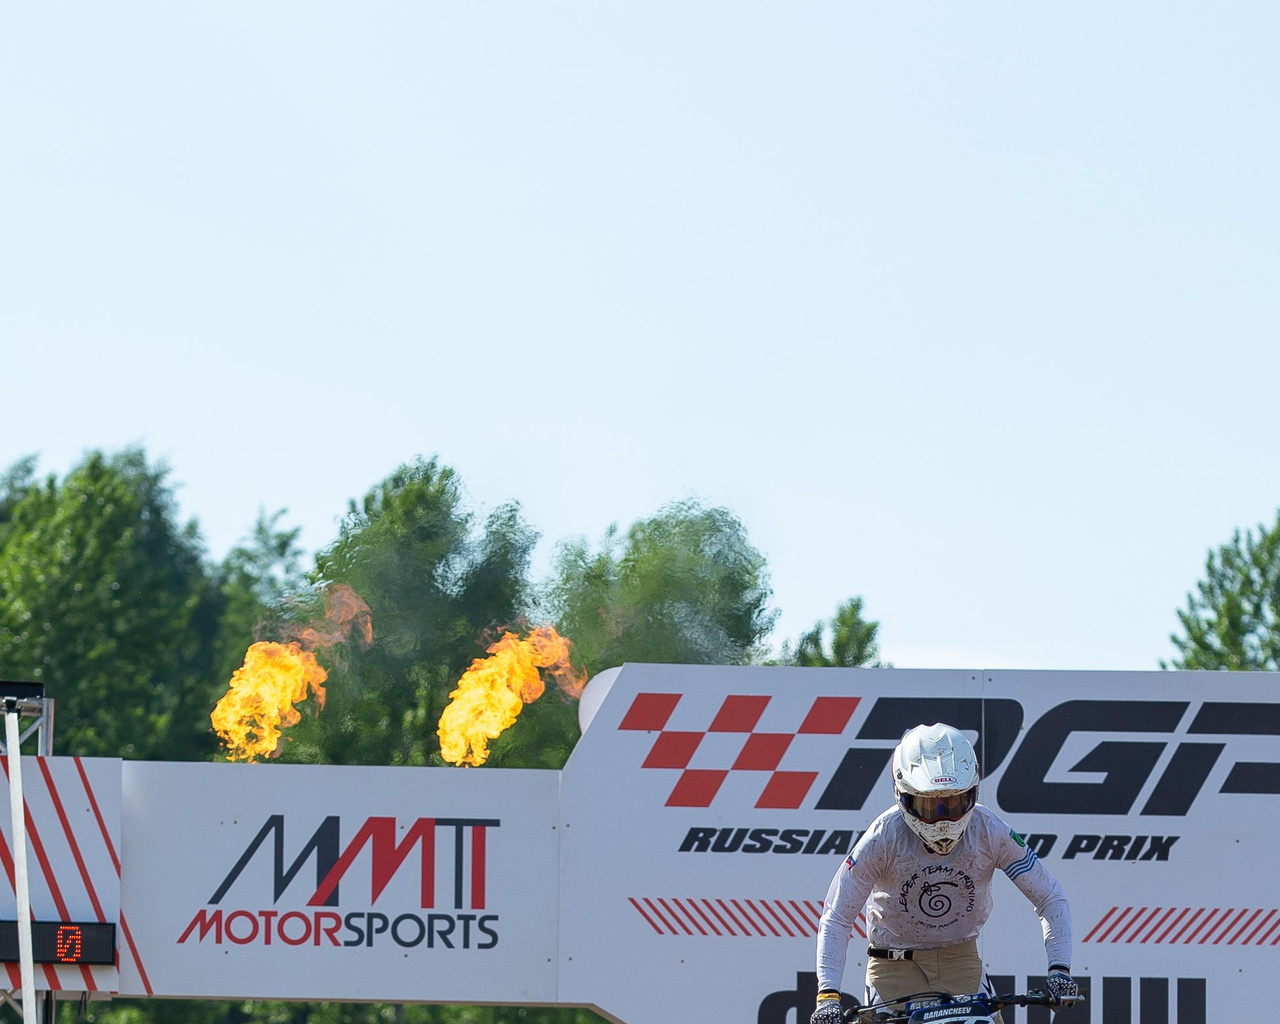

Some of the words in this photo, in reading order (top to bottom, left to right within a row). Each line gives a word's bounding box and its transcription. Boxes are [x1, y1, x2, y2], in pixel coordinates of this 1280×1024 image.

[207, 814, 501, 909] MMT
[677, 827, 867, 855] RUSSIA
[1062, 834, 1181, 861] PRIX
[899, 873, 919, 913] LEADER
[921, 865, 954, 876] TEAM
[955, 870, 976, 913] PROTVINO
[56, 926, 82, 962] 0
[176, 909, 499, 950] MOTORSPORTS
[923, 1006, 972, 1020] BARANCHEEV
